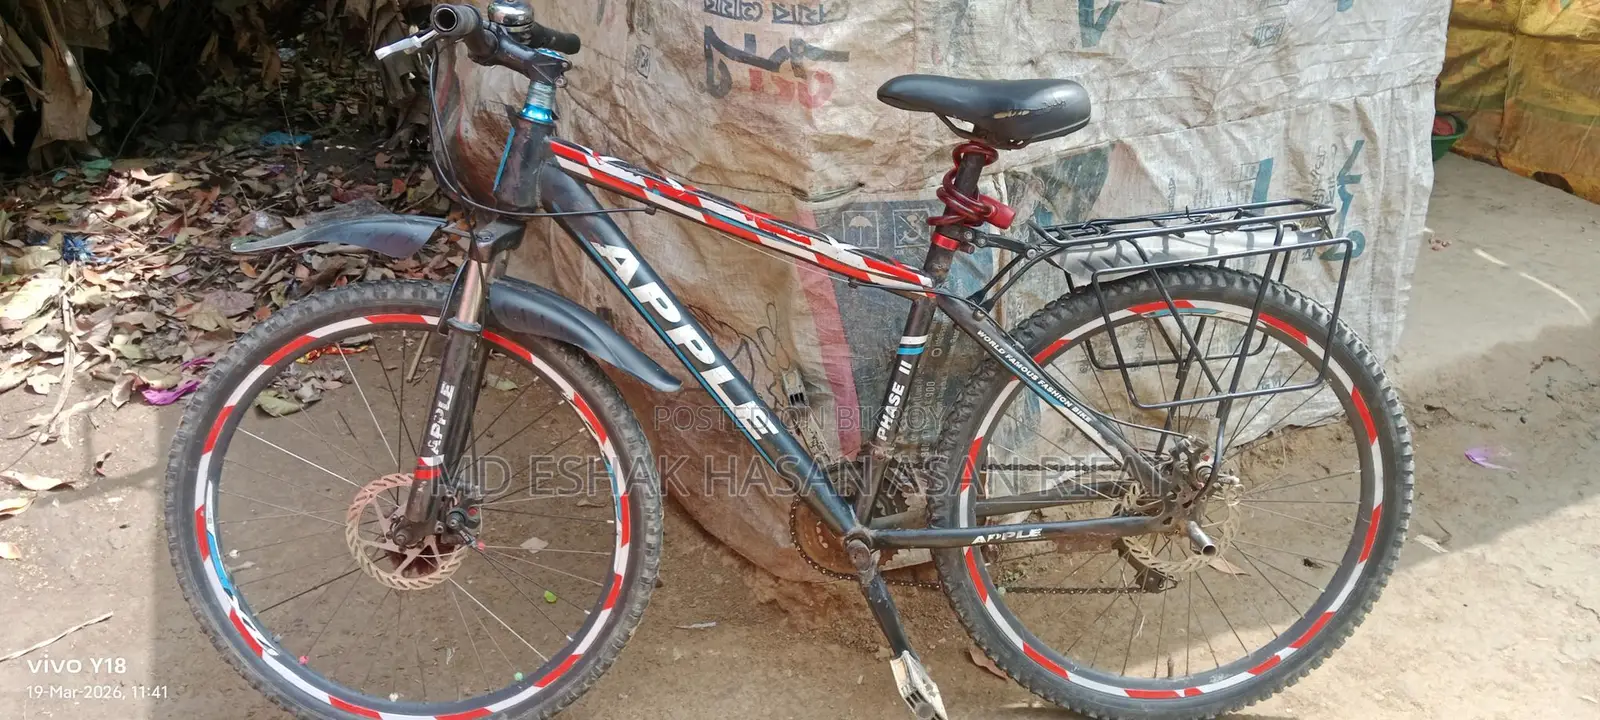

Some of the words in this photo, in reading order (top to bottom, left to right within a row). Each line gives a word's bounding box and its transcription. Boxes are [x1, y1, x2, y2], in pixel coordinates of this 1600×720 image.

[590, 241, 779, 440] APPLE
[977, 329, 1006, 354] WORLD
[1004, 353, 1039, 381] FAMOUS
[1037, 379, 1073, 408] FASHION
[1070, 404, 1093, 423] BIKE
[427, 383, 456, 455] APPLE
[876, 381, 906, 442] PHASE
[898, 359, 913, 376] II
[970, 527, 1043, 546] APPLE
